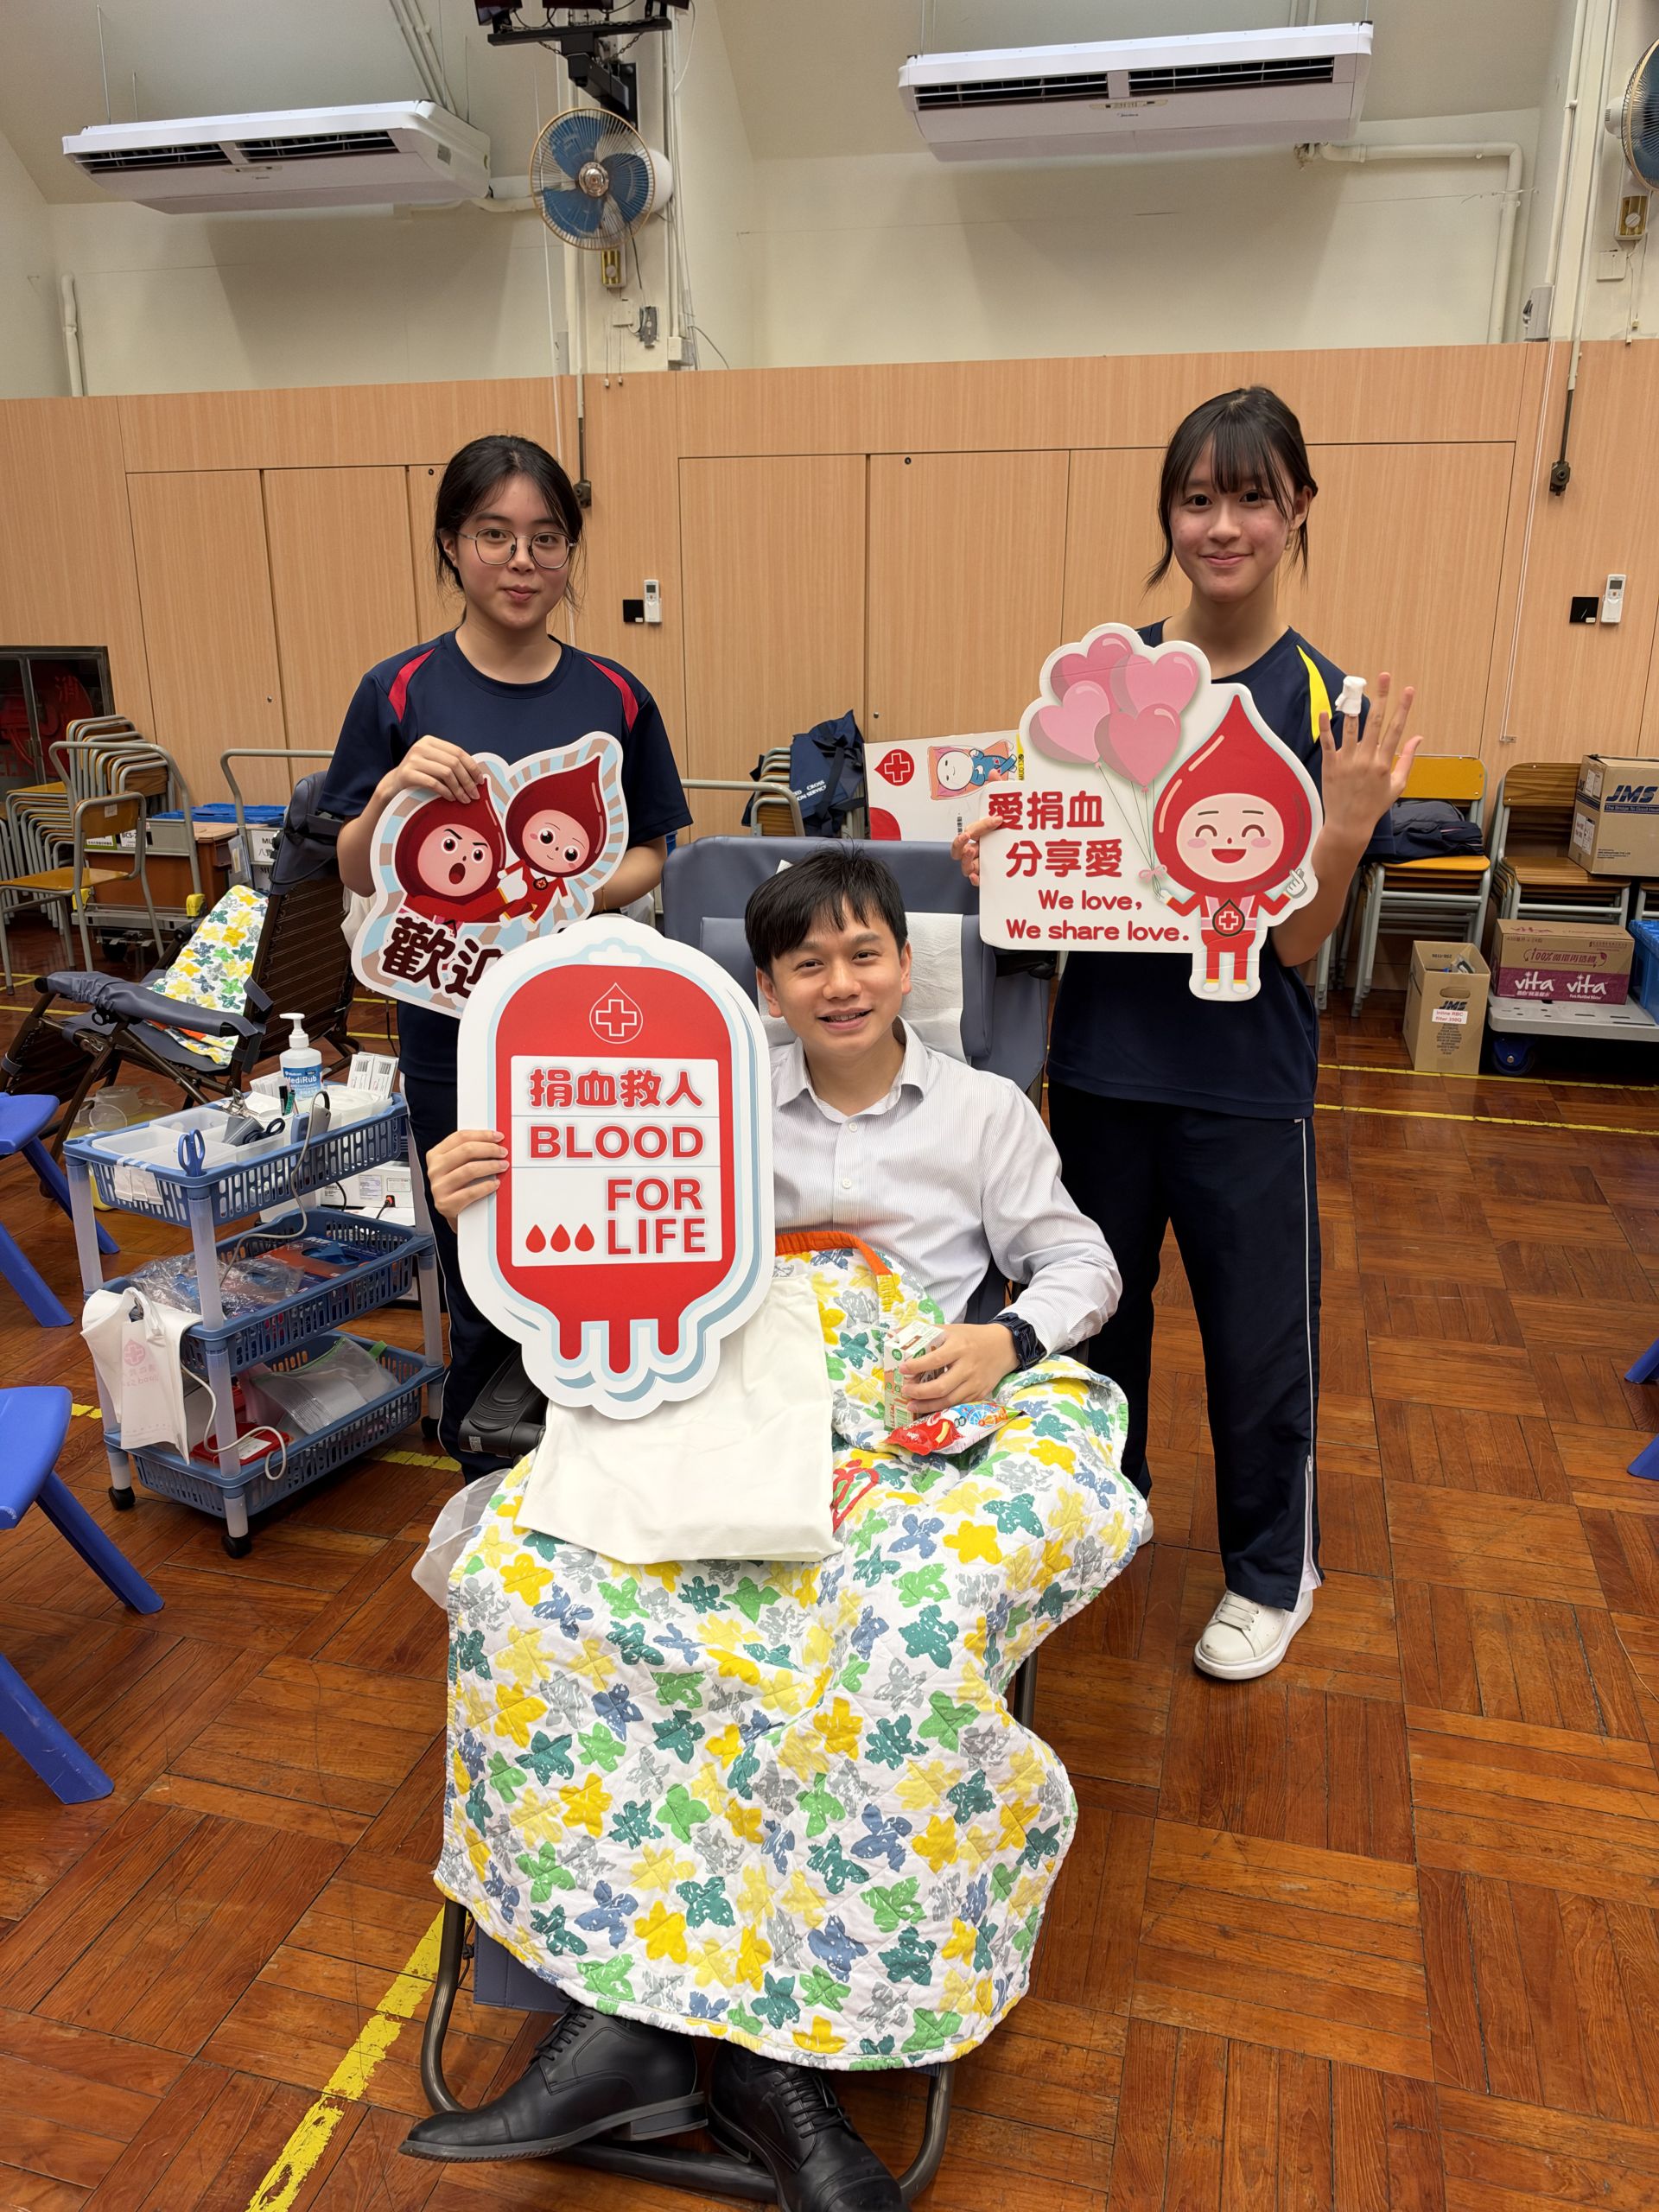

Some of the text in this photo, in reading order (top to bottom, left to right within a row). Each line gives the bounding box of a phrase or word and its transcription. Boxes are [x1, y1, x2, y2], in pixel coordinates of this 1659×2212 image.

[988, 791, 1104, 830] 愛捐血
[1605, 785, 1658, 804] JMS
[1006, 839, 1122, 878] 分享愛
[1038, 890, 1142, 911] We love,
[1006, 919, 1190, 941] We share love.
[382, 916, 503, 999] 歡迎
[1515, 971, 1554, 991] vita
[1567, 975, 1607, 995] vita
[1438, 1000, 1467, 1010] JMS
[529, 1068, 703, 1108] 捐血救人
[529, 1125, 704, 1159] BLOOD
[607, 1177, 704, 1211] FOR
[607, 1217, 706, 1255] LIFE
